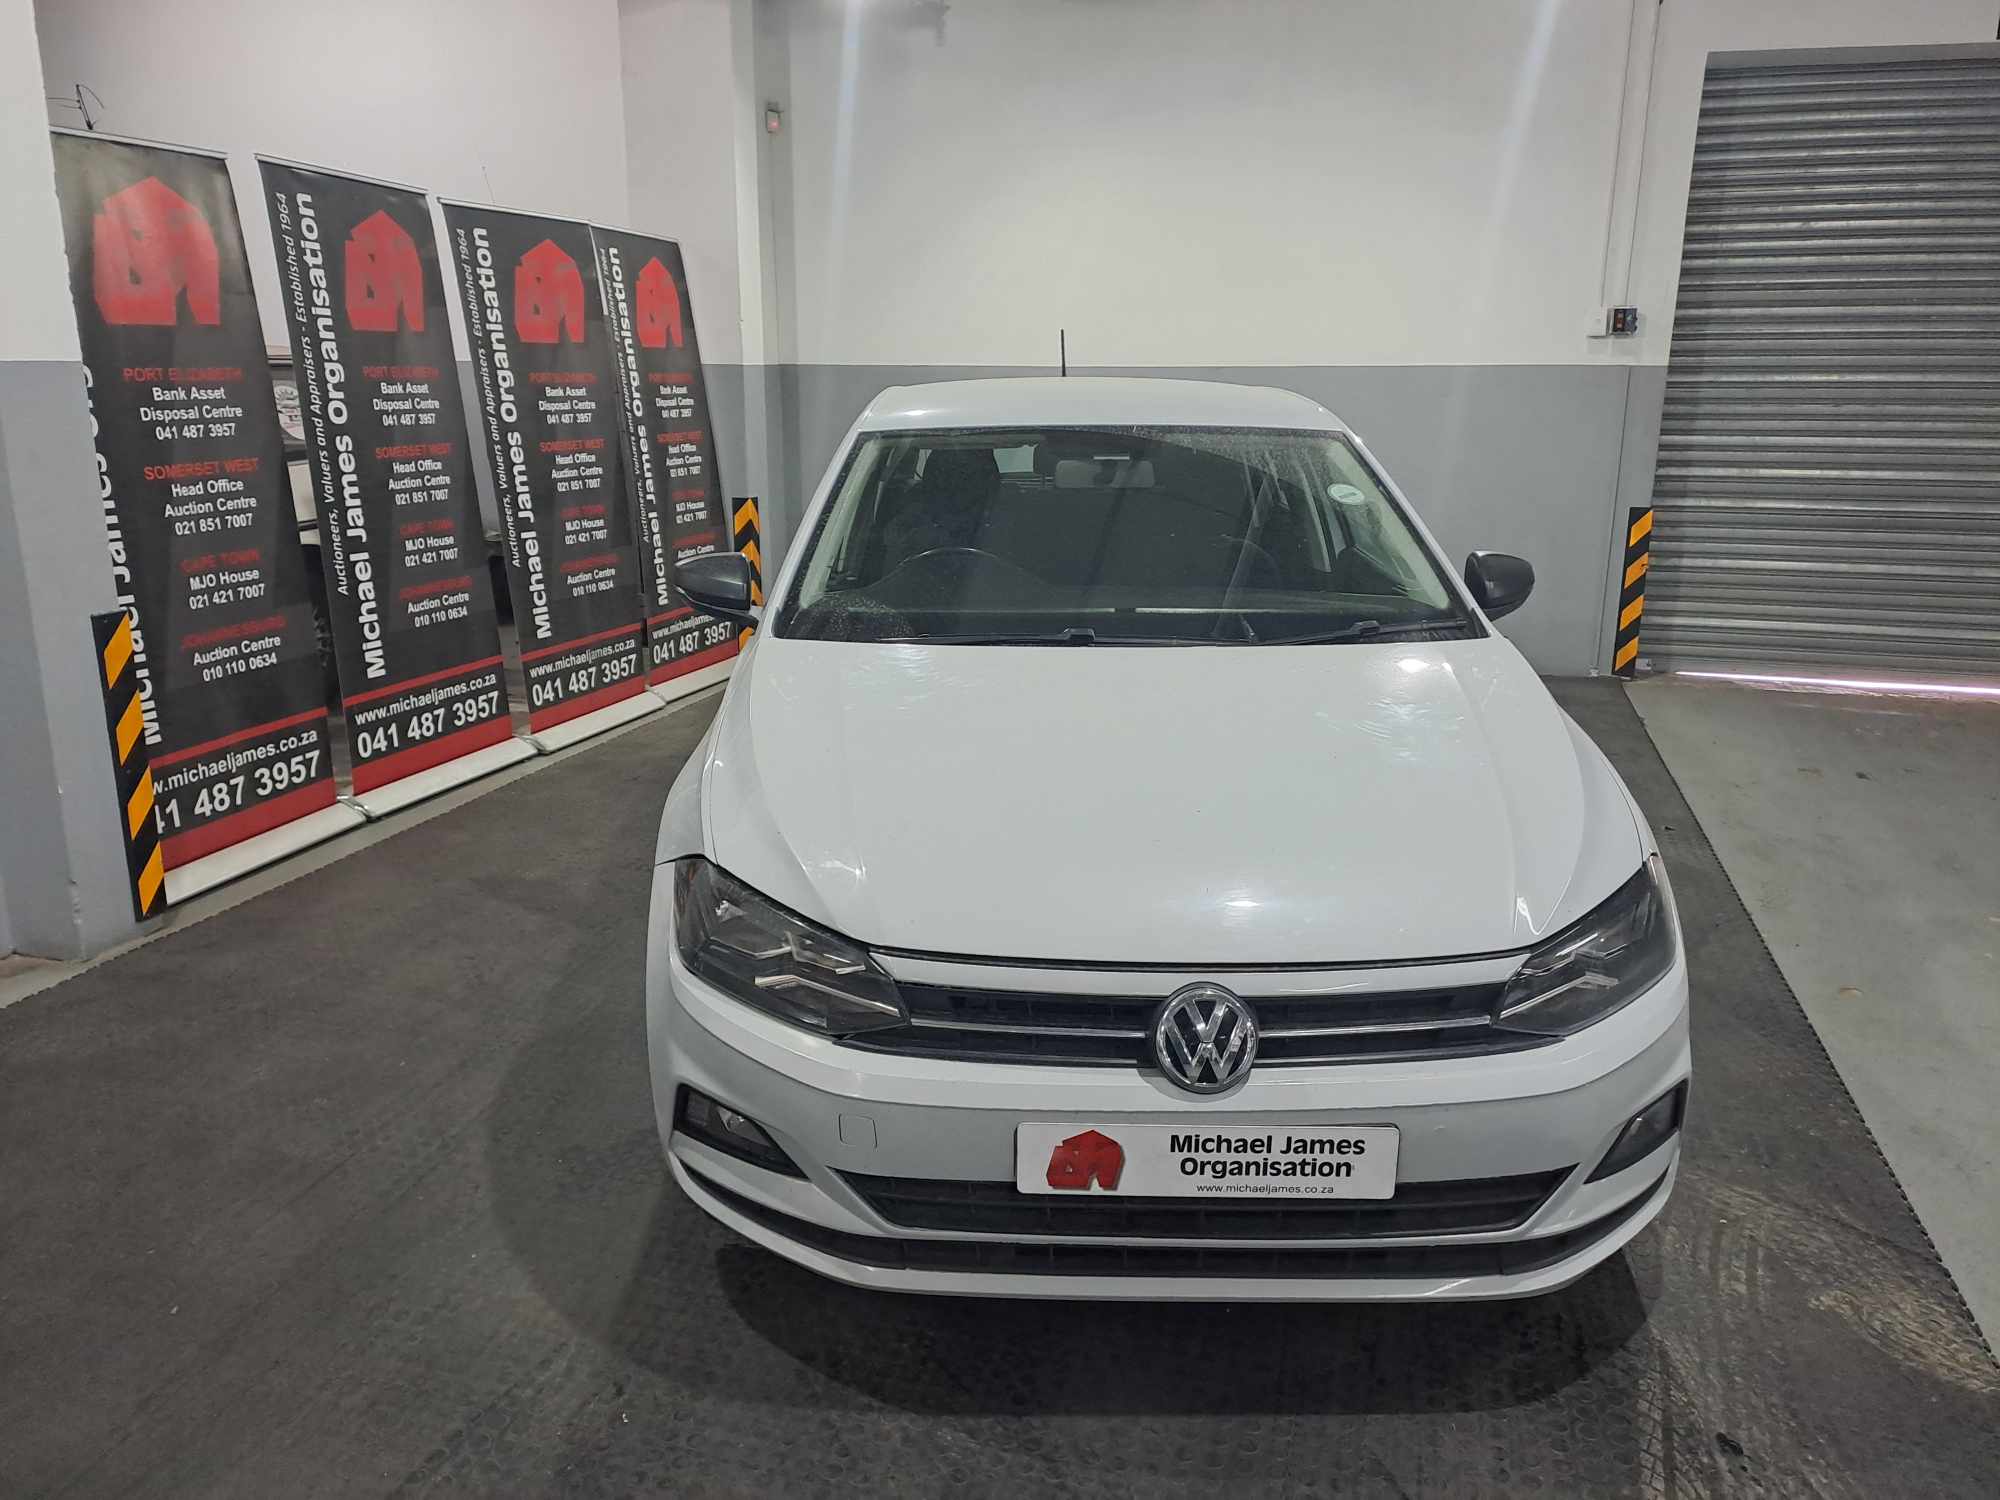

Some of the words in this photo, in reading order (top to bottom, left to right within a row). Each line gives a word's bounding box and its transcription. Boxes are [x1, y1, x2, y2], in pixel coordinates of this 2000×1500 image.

[276, 193, 292, 231] 1964
[456, 228, 471, 262] 1964
[283, 235, 307, 323] Established
[296, 193, 348, 425] Organisation
[460, 263, 482, 337] Established
[473, 227, 517, 423] Organisation
[609, 247, 642, 417] Organisation
[301, 335, 322, 414] Appraisers
[380, 382, 404, 394] Bank
[406, 382, 429, 394] Asset
[478, 346, 496, 415] Appraisers
[152, 387, 187, 401] Bank
[190, 386, 226, 400] Asset
[373, 398, 412, 412] Disposal
[414, 398, 440, 409] Centre
[140, 406, 198, 423] Disposal
[202, 405, 243, 419] Centre
[382, 414, 398, 426] 041
[400, 414, 416, 425] 487
[418, 413, 436, 424] 3957
[485, 415, 500, 440] and
[156, 426, 178, 440] 041
[182, 424, 204, 438] 487
[209, 423, 236, 437] 3957
[311, 417, 327, 446] and
[318, 450, 335, 503] Valuers
[393, 462, 415, 474] Head
[418, 459, 442, 471] Office
[495, 444, 508, 489] Valuers
[508, 432, 534, 523] James
[638, 424, 656, 504] James
[172, 481, 204, 497] Head
[207, 479, 244, 494] Office
[335, 435, 366, 542] James
[388, 477, 422, 490] Auction
[424, 474, 450, 487] Centre
[395, 494, 410, 505] 021
[413, 491, 428, 503] 851
[431, 489, 448, 501] 7007
[164, 500, 214, 518] Auction
[216, 495, 257, 511] Centre
[175, 520, 196, 536] 021
[200, 517, 221, 532] 851
[225, 513, 253, 530] 7007
[503, 494, 520, 568] Auctioneers,
[581, 519, 604, 528] House
[328, 508, 349, 596] Auctioneers,
[405, 539, 424, 551] MJO
[427, 535, 454, 548] House
[405, 555, 420, 568] 021
[422, 552, 437, 565] 421
[440, 548, 458, 562] 7007
[648, 511, 668, 606] Michael
[190, 574, 216, 590] MJO
[220, 568, 260, 585] House
[520, 531, 552, 639] Michael
[189, 593, 209, 610] 021
[212, 589, 233, 605] 421
[238, 583, 265, 600] 7007
[407, 598, 440, 614] Auction
[442, 592, 470, 606] Centre
[350, 552, 386, 679] Michael
[414, 615, 430, 628] 010
[432, 610, 446, 624] 110
[448, 606, 468, 621] 0634
[652, 614, 714, 640] www.michaeljames
[193, 644, 238, 666] Auction
[241, 634, 281, 654] Centre
[529, 638, 635, 679] www.michaeljames.co.za
[653, 643, 675, 664] 041
[679, 627, 699, 652] 487
[704, 621, 732, 646] 3957
[202, 666, 222, 682] 010
[226, 660, 245, 677] 110
[249, 652, 277, 670] 0634
[532, 679, 563, 707] 041
[568, 667, 597, 694] 487
[602, 654, 637, 683] 3957
[355, 672, 497, 726] www.michaeljames.co.za
[357, 722, 399, 759] 041
[407, 707, 445, 741] 487
[452, 690, 499, 728] 3957
[153, 728, 317, 795] w.michaeljames.co.za
[193, 776, 245, 819] 487
[253, 749, 320, 796] 3957
[1170, 1134, 1272, 1155] Michael
[1280, 1135, 1365, 1156] James
[1180, 1156, 1352, 1179] Organisation
[1196, 1184, 1334, 1195] www.michaeljames.co.za
